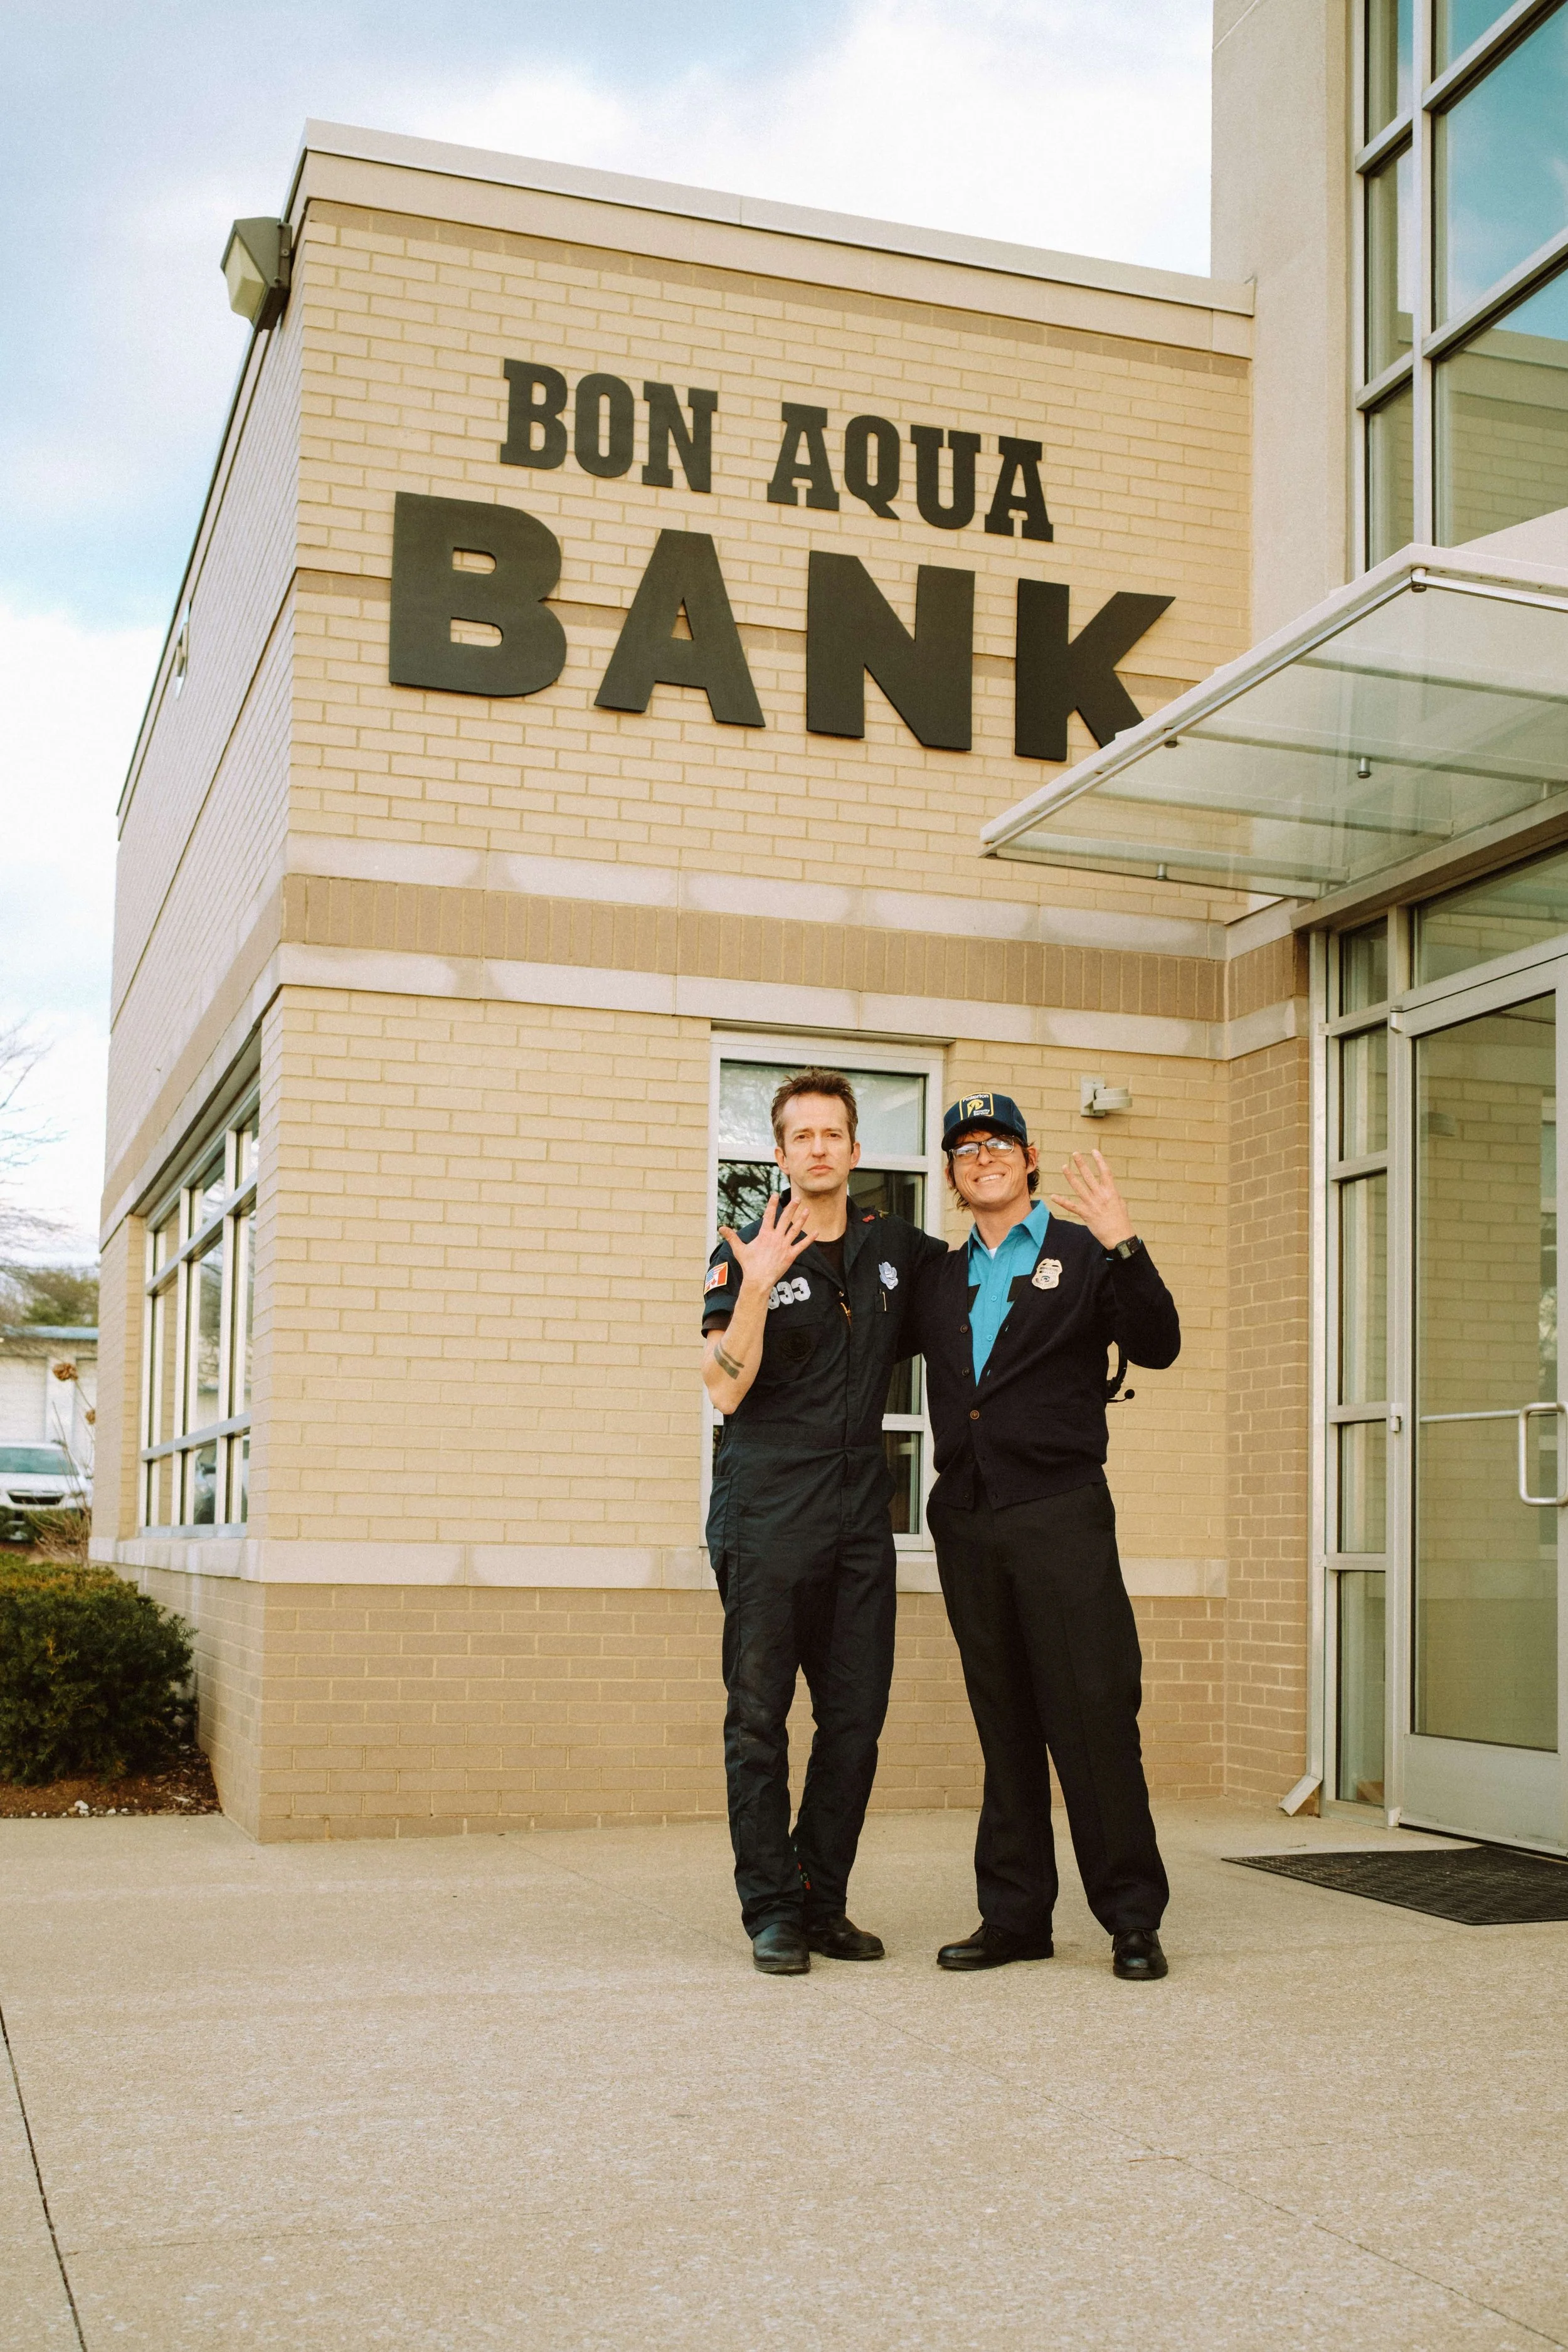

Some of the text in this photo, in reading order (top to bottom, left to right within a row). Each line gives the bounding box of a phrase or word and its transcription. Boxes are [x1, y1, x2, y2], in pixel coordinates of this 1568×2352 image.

[500, 358, 1054, 543] BON AQUA
[388, 491, 1176, 761] BANK
